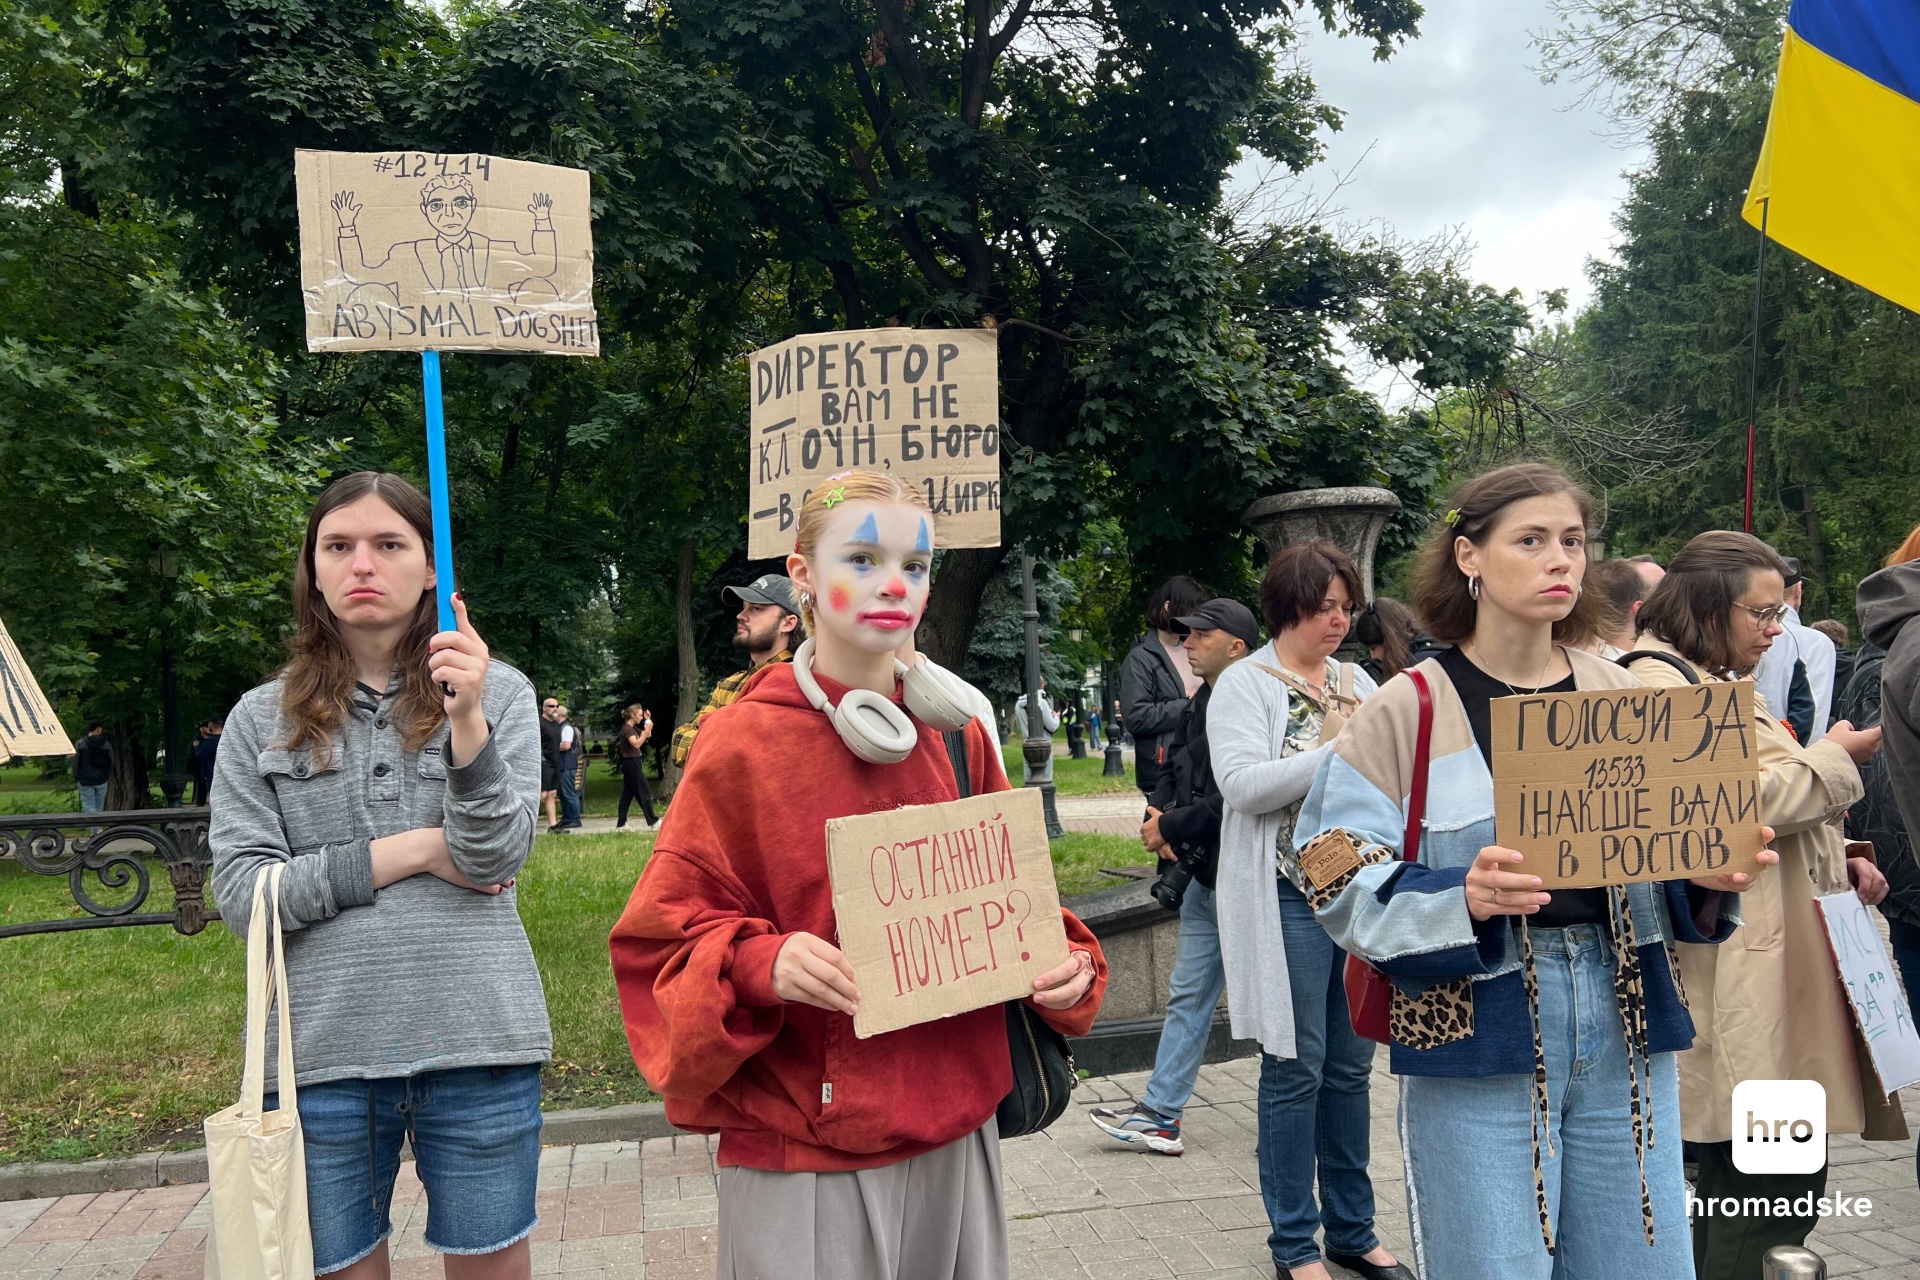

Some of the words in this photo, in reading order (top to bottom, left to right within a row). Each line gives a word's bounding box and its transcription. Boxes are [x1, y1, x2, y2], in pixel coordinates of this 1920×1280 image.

[373, 153, 490, 181] #12414
[333, 302, 491, 340] ABYSMAL
[494, 306, 597, 347] DOGSHIT
[821, 388, 890, 426] ВАМ
[913, 384, 959, 420] НЕ
[901, 423, 998, 461] БЮРО
[922, 475, 999, 516] ЦИРК
[1517, 689, 1672, 751] ГОЛОСУЙ
[1672, 686, 1748, 763] ЗА
[1584, 755, 1647, 790] 13533
[1519, 784, 1652, 839] ІНАКШЕ
[1670, 779, 1759, 827] ВАЛИ
[870, 813, 1017, 907] ОСТАННІЙ
[1318, 850, 1339, 868] Polo
[1557, 839, 1580, 879] В
[1601, 826, 1731, 880] РОСТОВ
[884, 889, 1032, 997] НОМЕР?
